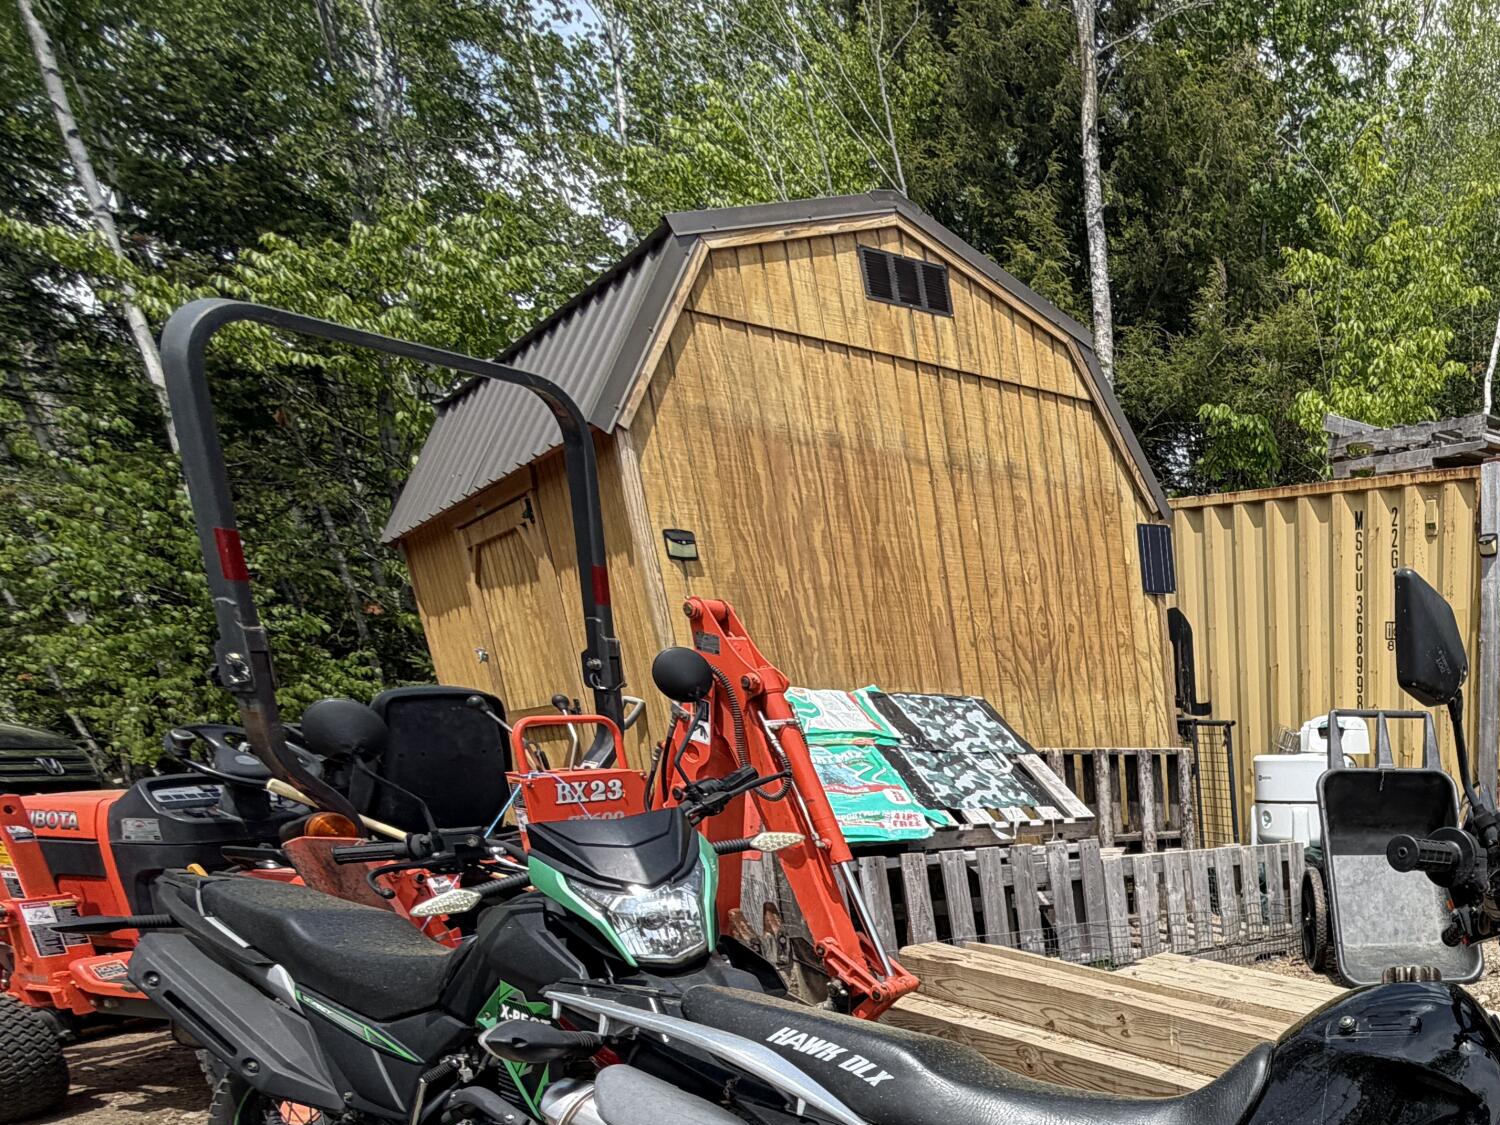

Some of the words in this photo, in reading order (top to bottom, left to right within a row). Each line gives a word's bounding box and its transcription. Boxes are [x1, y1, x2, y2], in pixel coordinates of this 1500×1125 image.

[1391, 507, 1399, 575] 22G
[555, 779, 624, 804] BX23
[766, 1026, 849, 1062] HAWK
[838, 1054, 895, 1087] DLX
